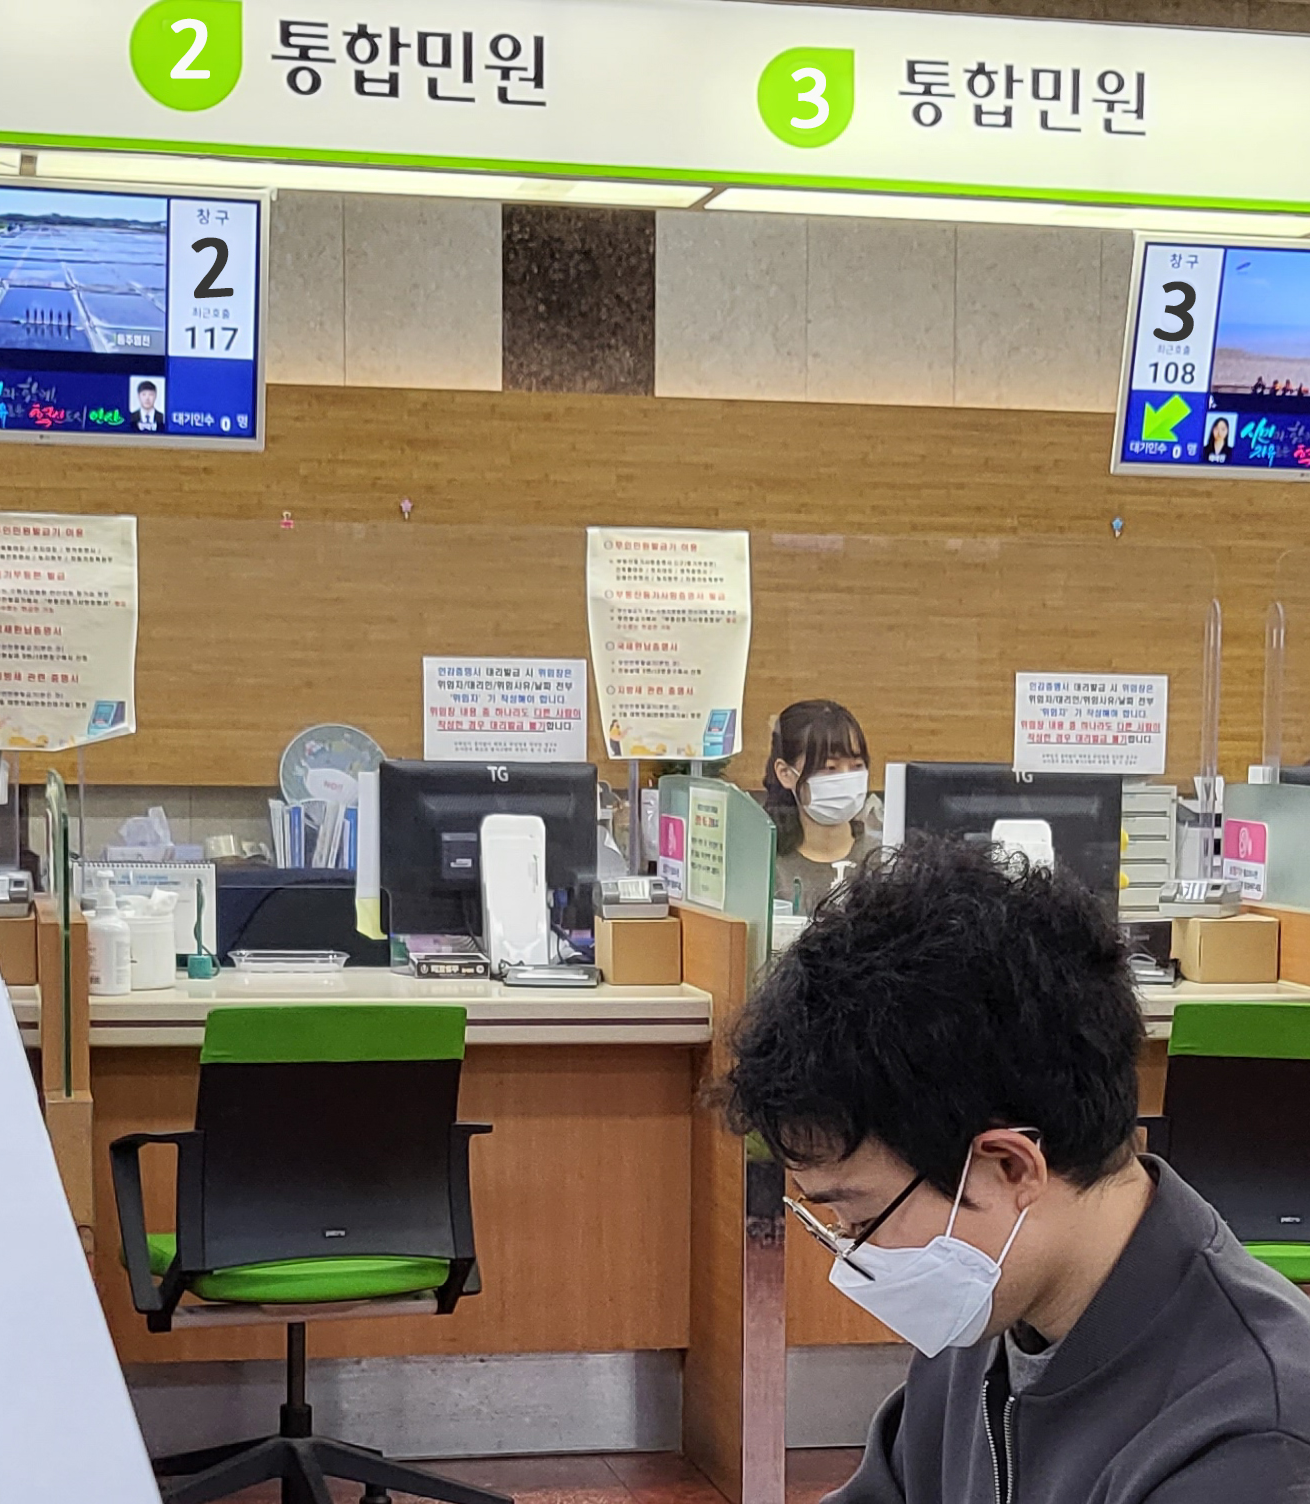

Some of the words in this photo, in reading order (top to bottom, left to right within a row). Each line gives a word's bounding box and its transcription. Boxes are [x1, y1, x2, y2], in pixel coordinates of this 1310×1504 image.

[170, 18, 210, 80] 2
[271, 18, 548, 108] 통합민원
[789, 68, 830, 129] 3
[898, 56, 1146, 138] 통합민원
[191, 237, 234, 298] 2
[1153, 281, 1196, 341] 3
[185, 327, 238, 351] 117
[1148, 362, 1195, 385] 108
[172, 411, 215, 428] 대기인수
[221, 417, 231, 432] 0
[237, 414, 248, 429] 명
[1130, 441, 1167, 455] 대기인수
[1172, 445, 1181, 459] 0
[1187, 443, 1197, 457] 명
[487, 766, 509, 782] TG
[1015, 771, 1034, 783] TG
